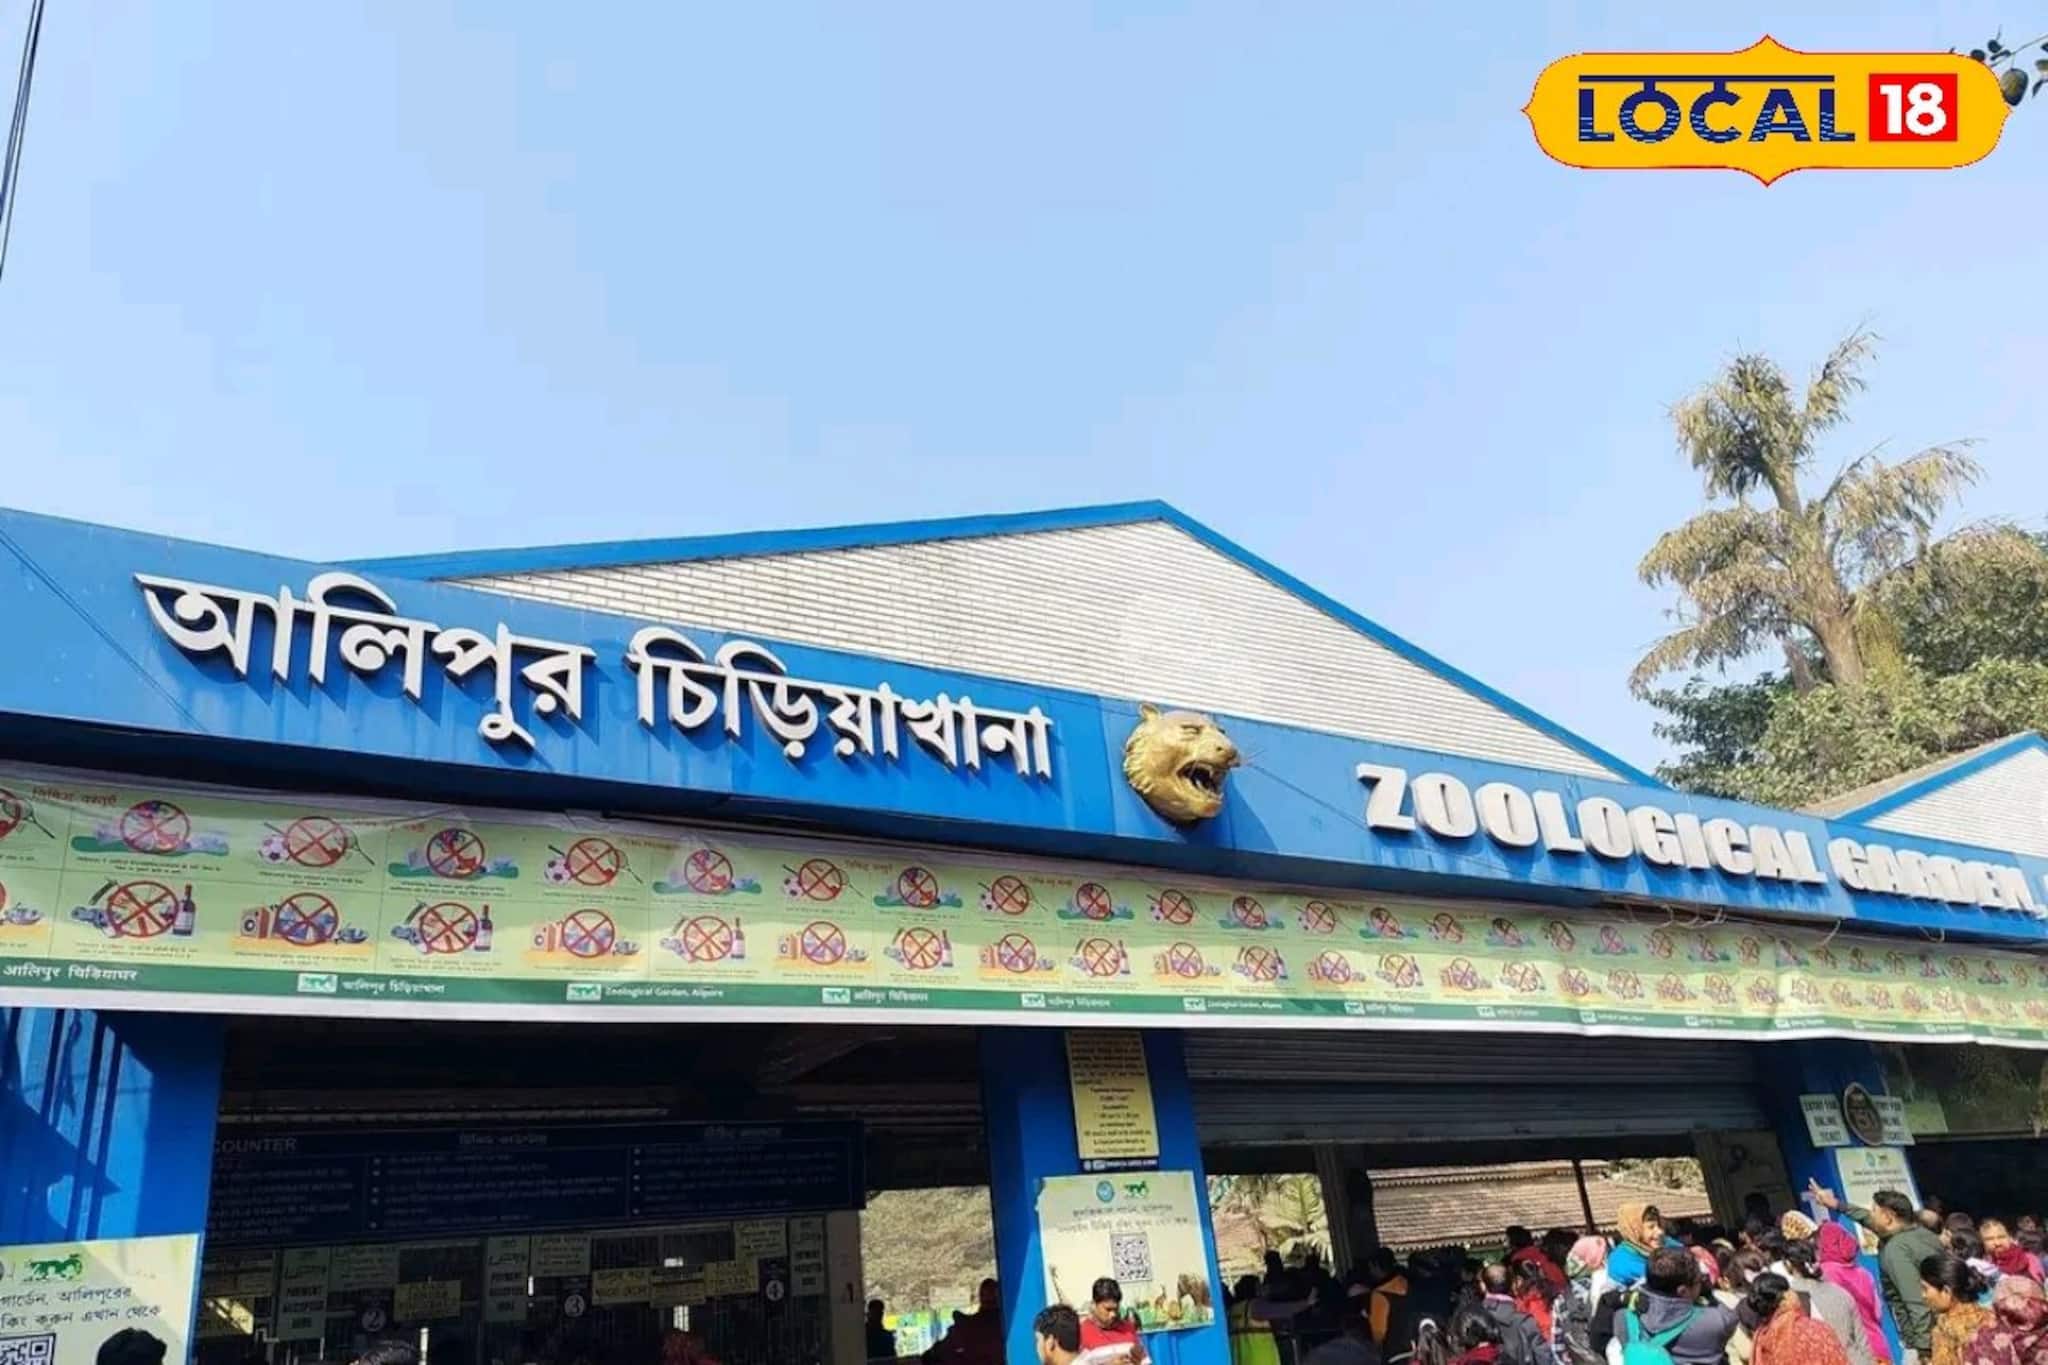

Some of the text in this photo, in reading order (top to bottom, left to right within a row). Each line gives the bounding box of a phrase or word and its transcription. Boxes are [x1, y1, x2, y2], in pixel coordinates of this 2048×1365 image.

[132, 571, 1054, 783] আলিপুর চিড়িয়াখানা
[1356, 761, 1828, 885] ZOOLOGICAL
